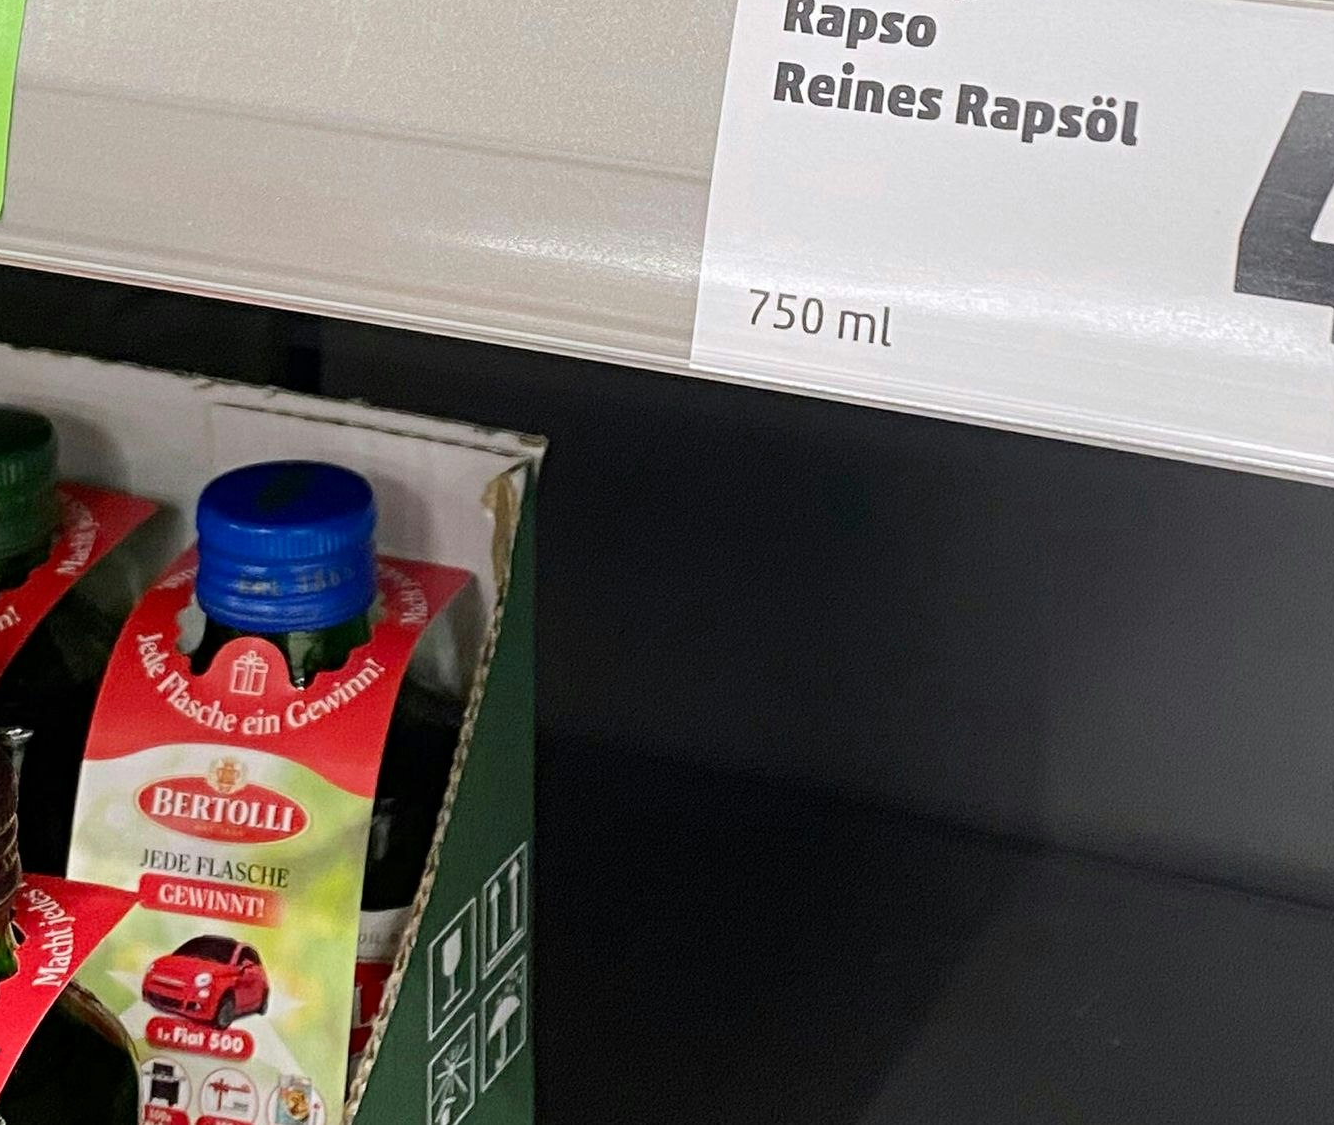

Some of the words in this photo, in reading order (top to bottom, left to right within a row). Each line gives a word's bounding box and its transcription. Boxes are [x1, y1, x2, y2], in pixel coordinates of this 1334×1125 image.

[773, 61, 944, 121] Reines
[955, 84, 1140, 146] Rapsöl
[748, 288, 824, 336] 750
[837, 306, 893, 348] ml
[136, 631, 169, 679] Jede
[157, 671, 237, 733] Flasche
[242, 708, 281, 735] ein
[286, 657, 386, 728] Gewinn!
[150, 786, 295, 833] BERTOLLI
[140, 848, 192, 873] JEDE
[195, 856, 291, 888] FLASCHE
[158, 883, 265, 918] GEWINNT!
[31, 926, 75, 988] Macht
[172, 1025, 205, 1047] Fiat
[209, 1032, 245, 1053] 500
